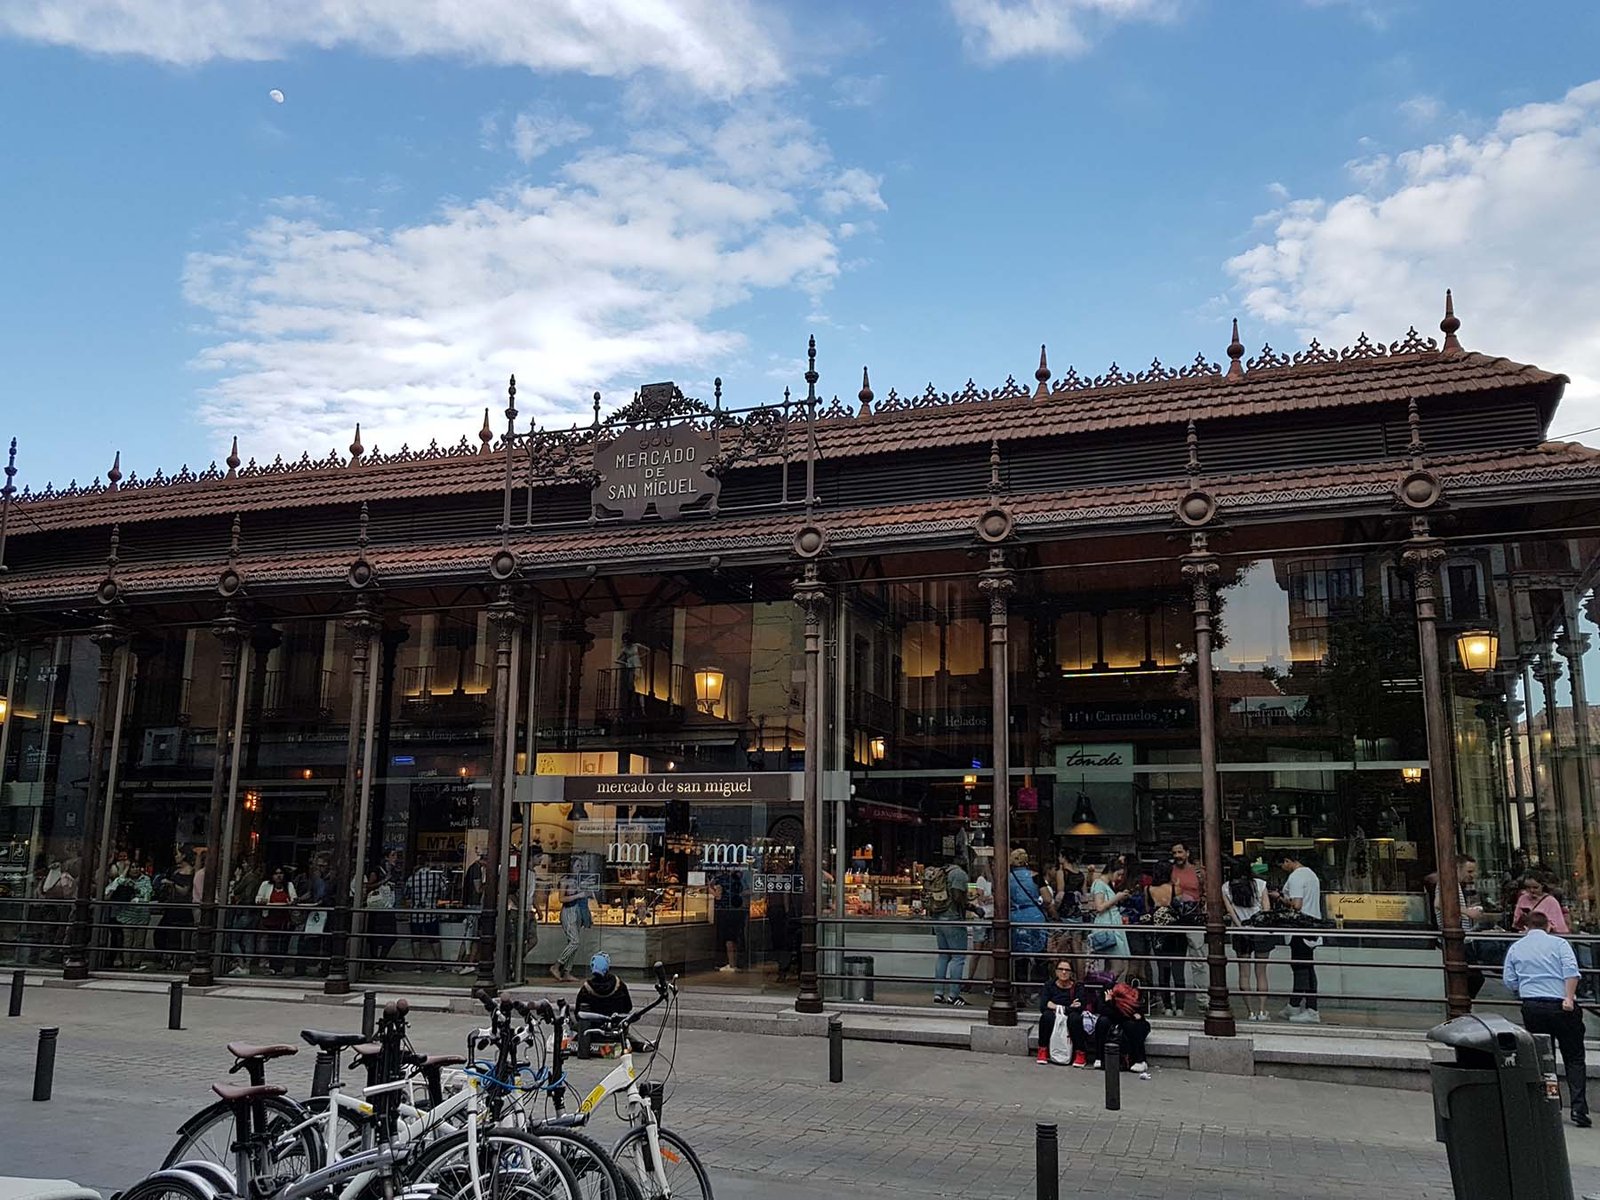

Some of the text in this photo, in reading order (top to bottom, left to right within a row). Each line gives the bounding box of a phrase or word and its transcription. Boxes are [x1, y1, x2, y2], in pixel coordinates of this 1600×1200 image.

[615, 447, 695, 468] MERCADO
[645, 467, 665, 479] DE
[608, 478, 697, 500] SAN MIGUEL
[945, 715, 987, 727] Helados
[1095, 708, 1157, 722] Caramelos
[597, 778, 752, 798] mercado de san miguel
